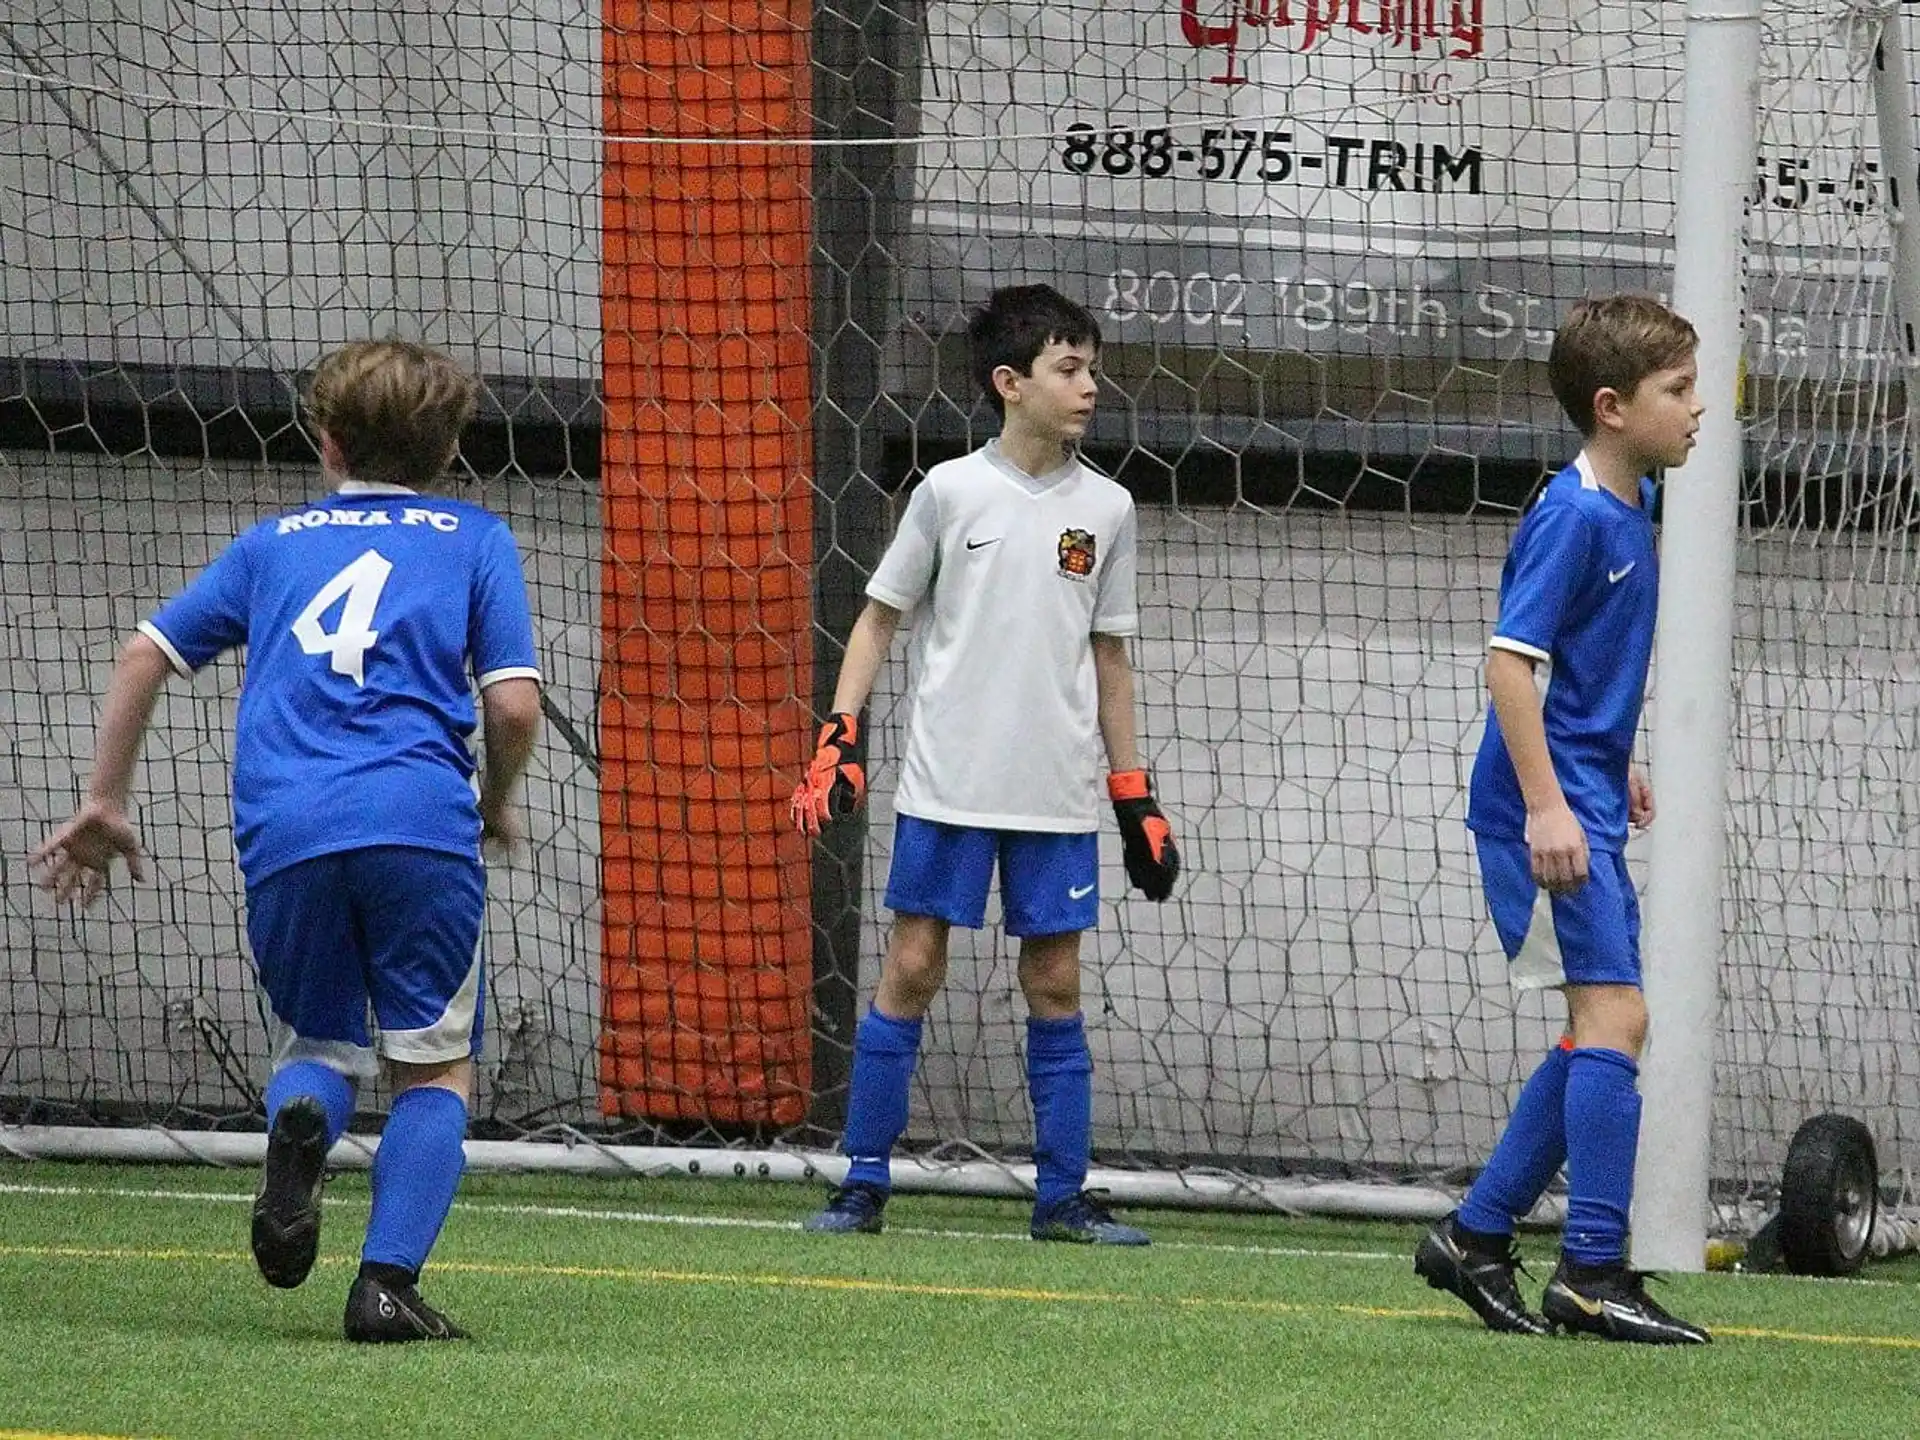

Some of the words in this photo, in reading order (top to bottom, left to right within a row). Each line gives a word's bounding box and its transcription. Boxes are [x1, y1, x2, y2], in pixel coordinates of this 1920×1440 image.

[1061, 121, 1482, 195] 888-575-TRIM
[1103, 267, 1246, 326] 8002
[1274, 276, 1448, 338] 189th
[277, 508, 393, 535] ROMA
[401, 507, 460, 532] FC
[290, 548, 394, 688] 4
